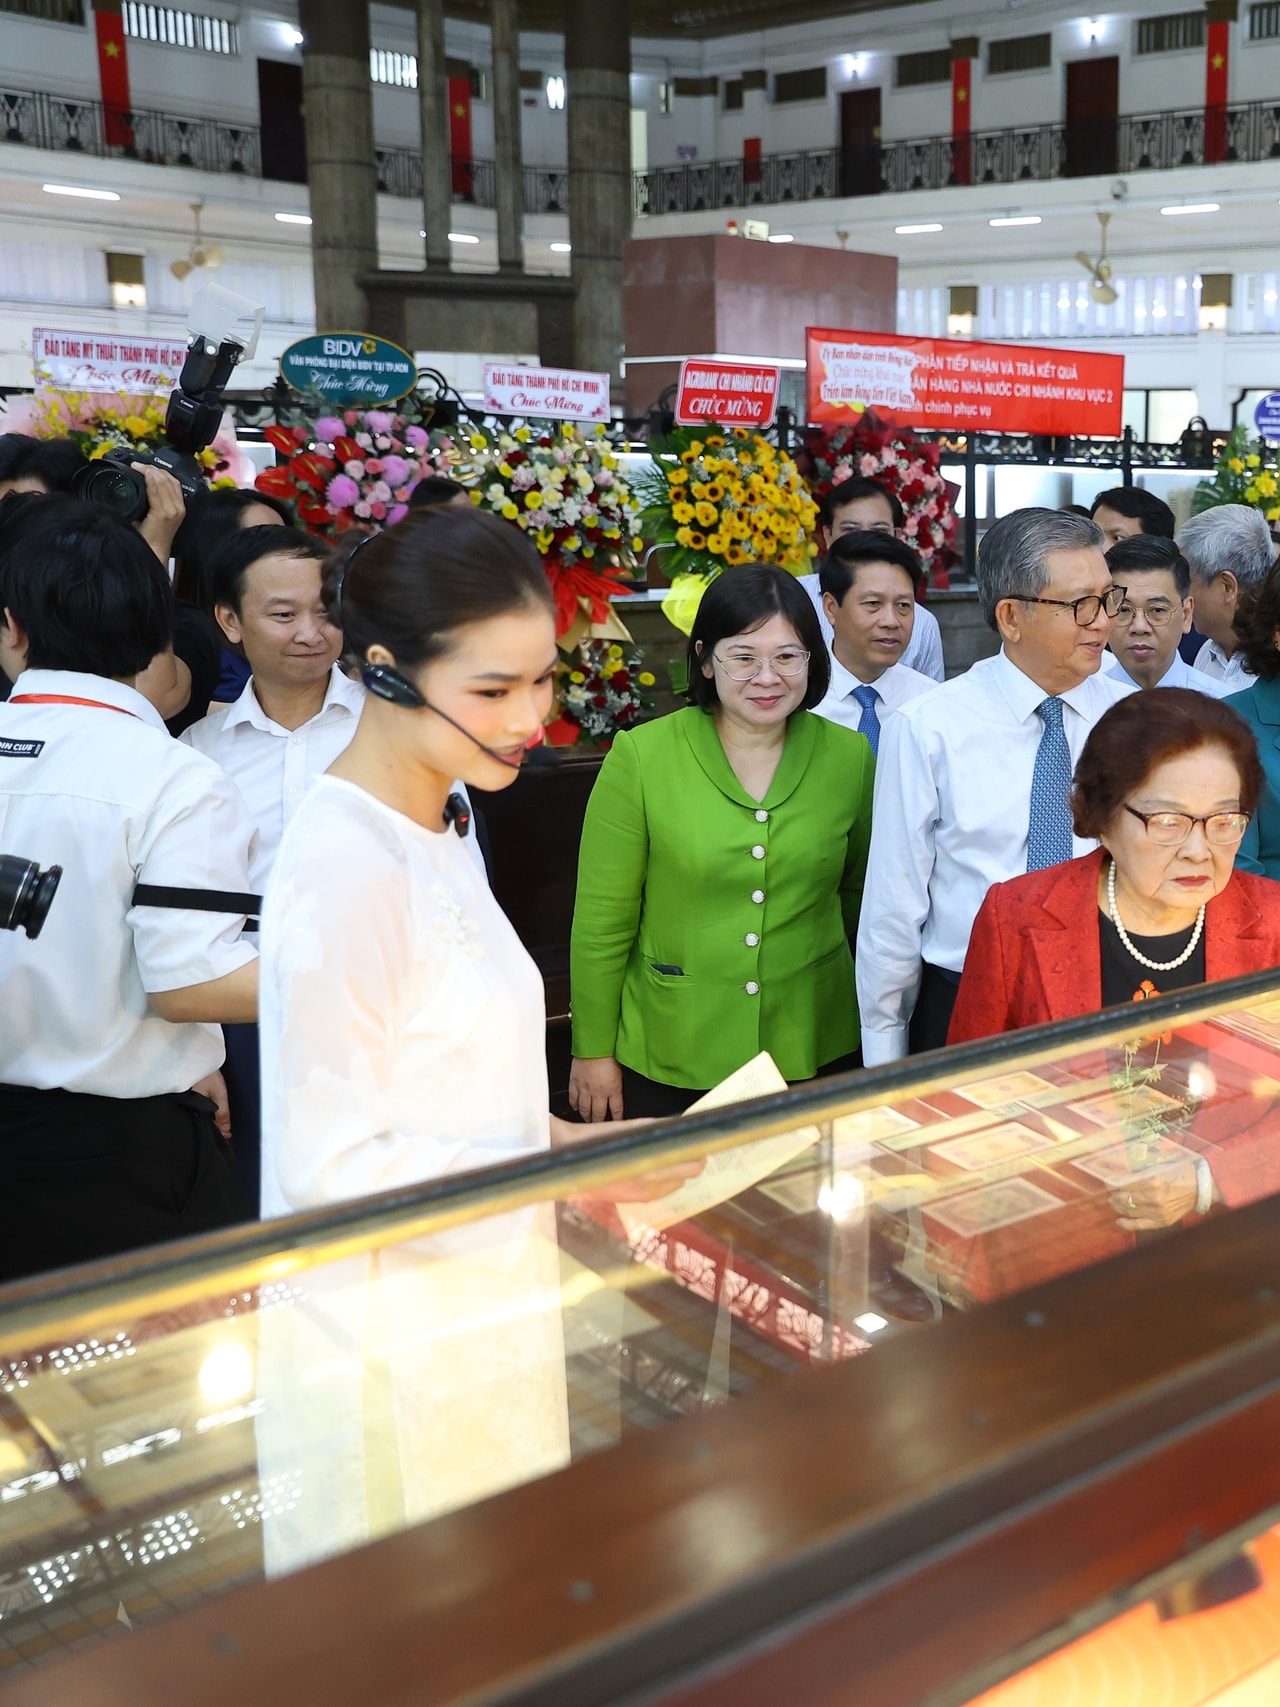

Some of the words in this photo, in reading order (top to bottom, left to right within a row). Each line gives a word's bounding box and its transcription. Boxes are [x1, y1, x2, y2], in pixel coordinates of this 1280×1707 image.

[61, 337, 81, 358] TÀNG
[323, 338, 363, 357] BIDV
[946, 354, 970, 372] TIẾP
[971, 357, 999, 378] NHẬN
[1001, 359, 1015, 376] VÀ
[507, 371, 525, 388] TÀNG
[583, 381, 600, 394] MINH
[929, 376, 960, 393] HÀNG
[961, 379, 984, 396] NHÀ
[1013, 383, 1031, 398] CHI
[1066, 387, 1086, 402] KHU
[1106, 391, 1114, 404] 2
[510, 392, 542, 408] Chúc
[688, 393, 726, 415] CHÚC
[725, 396, 764, 417] MỪNG
[13, 743, 34, 751] CLUB
